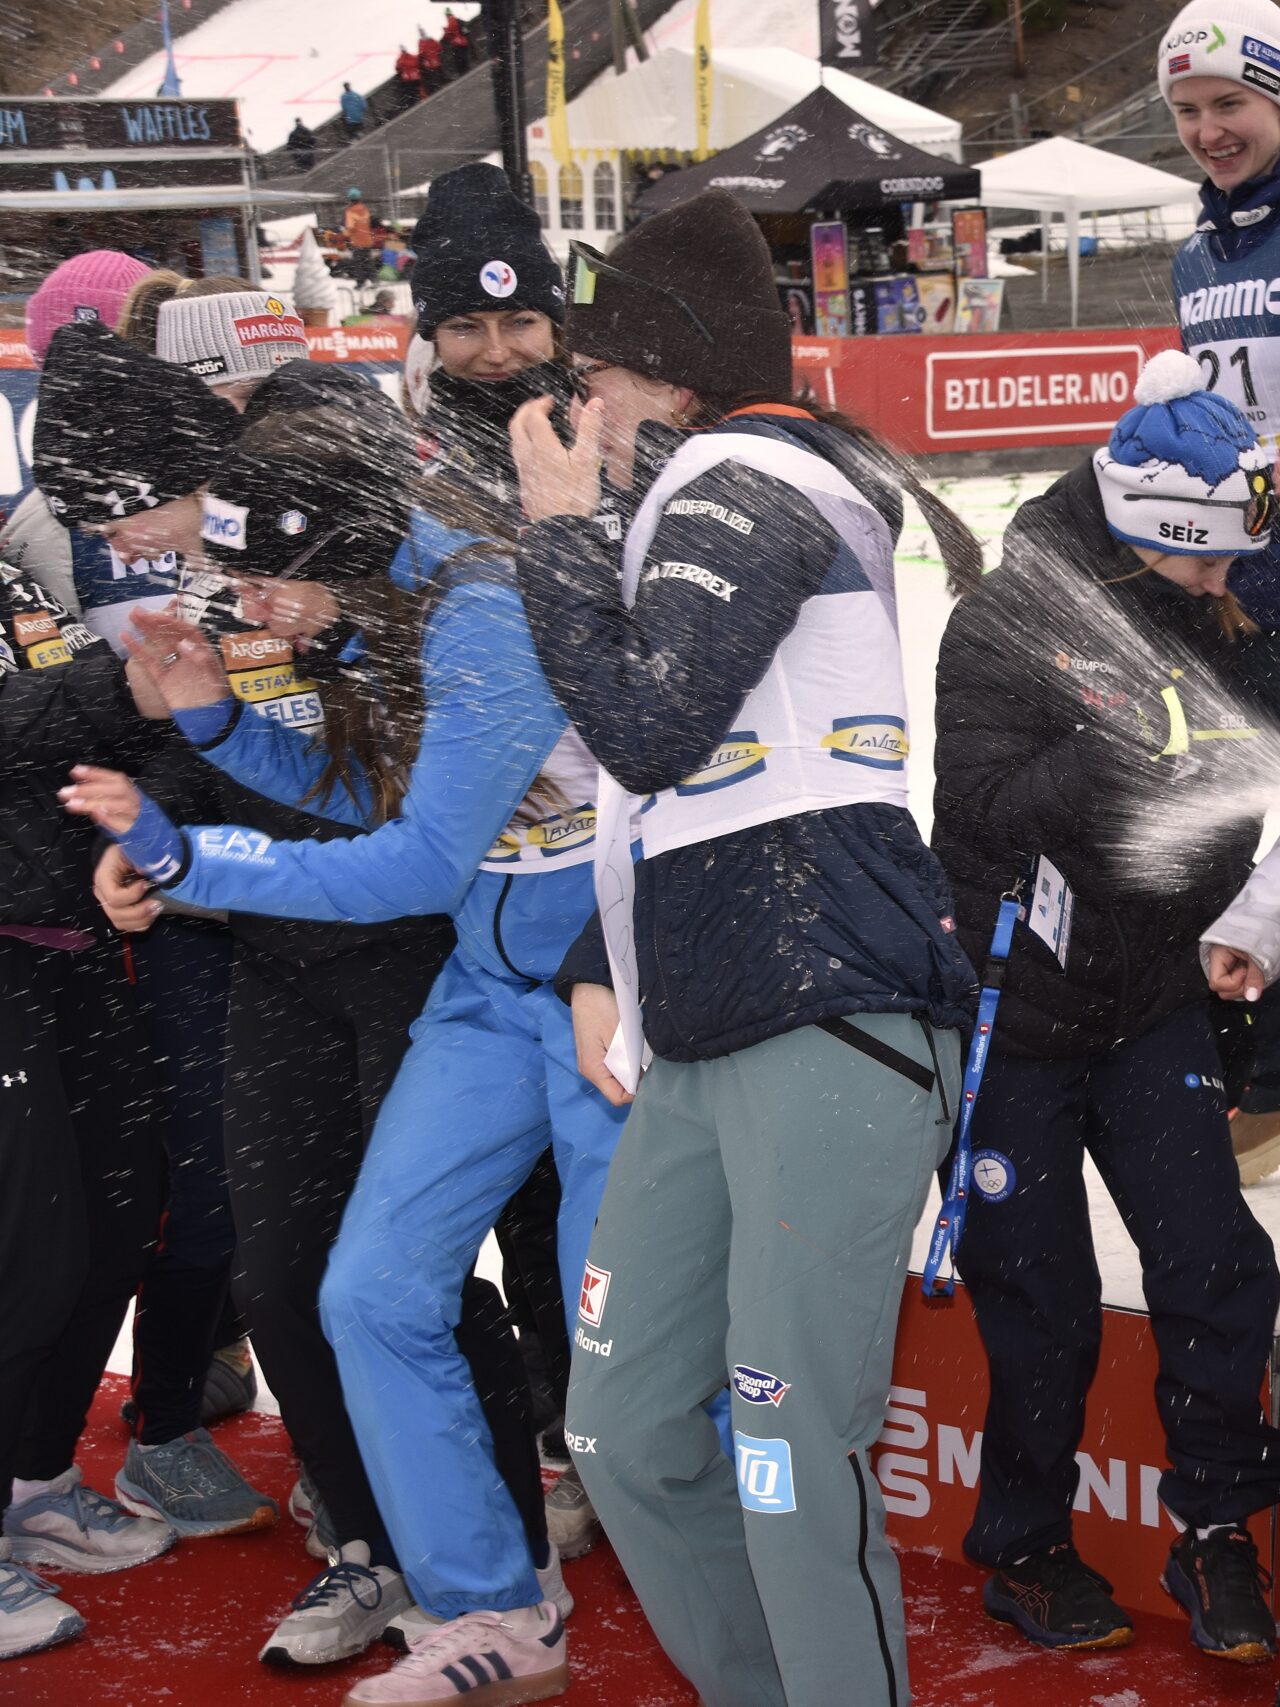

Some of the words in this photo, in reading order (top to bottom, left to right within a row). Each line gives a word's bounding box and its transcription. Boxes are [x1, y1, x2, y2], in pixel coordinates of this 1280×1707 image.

[120, 105, 212, 142] WAFFLES
[944, 370, 1129, 411] BILDELER.NO
[660, 561, 739, 602] TERREX
[229, 638, 294, 660] ARGETA
[197, 827, 273, 856] EA7
[971, 1034, 987, 1074] SpareBank
[991, 1151, 1009, 1166] TEAM
[930, 1228, 946, 1266] SpareBank
[734, 1368, 776, 1390] personal
[737, 1380, 762, 1398] shop
[737, 1444, 783, 1504] TQ
